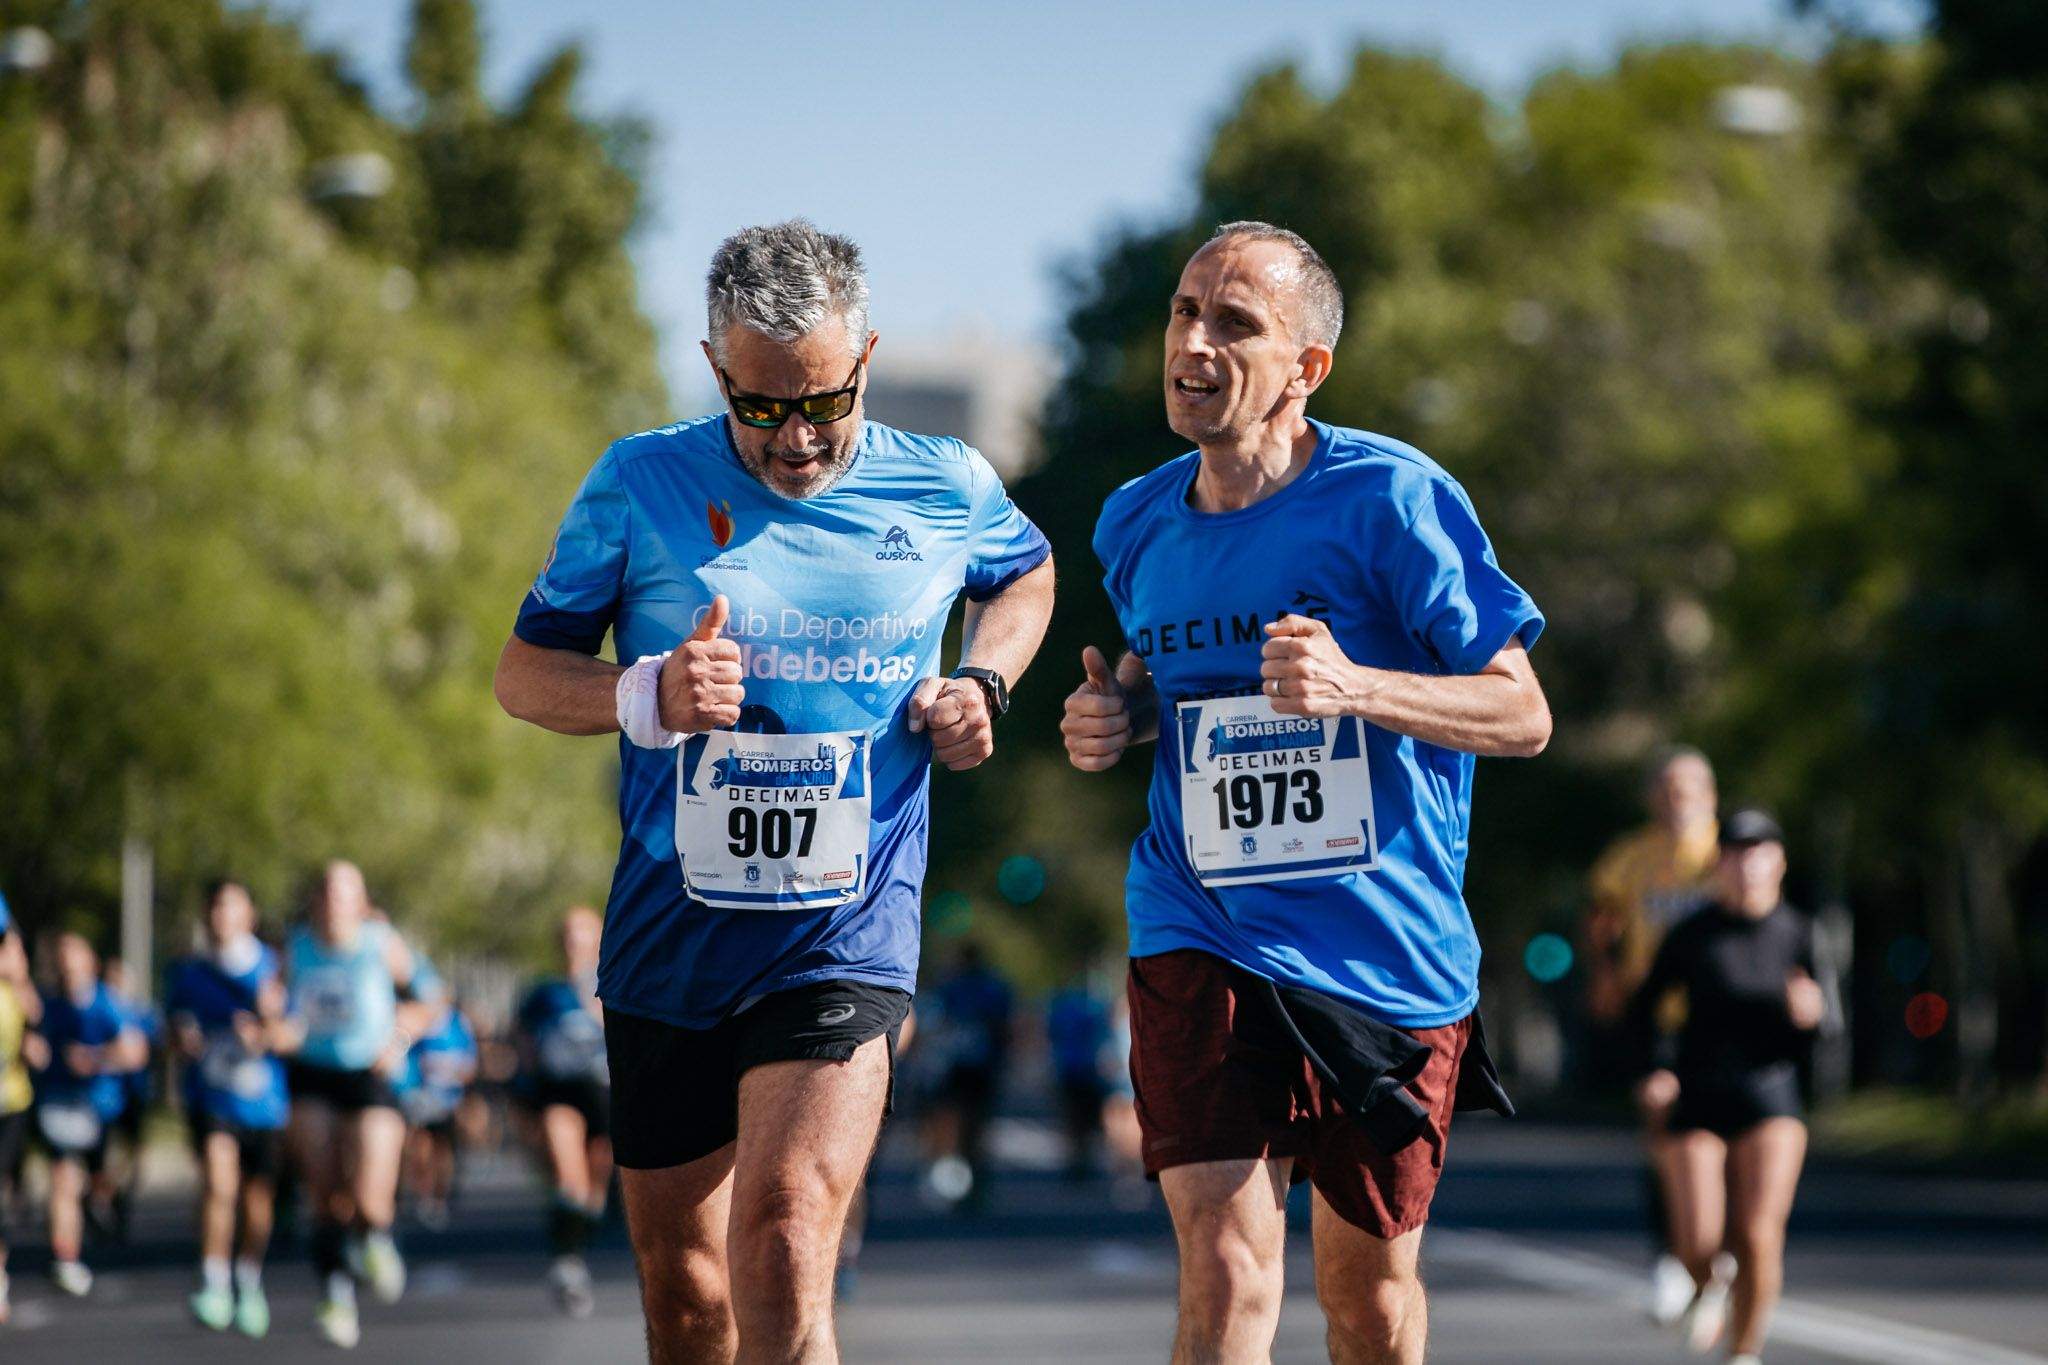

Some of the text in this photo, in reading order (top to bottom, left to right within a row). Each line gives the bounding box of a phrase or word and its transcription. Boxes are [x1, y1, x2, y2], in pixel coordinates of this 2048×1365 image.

[875, 551, 924, 562] austral
[779, 608, 928, 647] Deportivo
[1226, 714, 1258, 724] CARRERA
[1225, 718, 1321, 739] BOMBEROS
[740, 750, 776, 759] CARRERA
[1219, 748, 1322, 772] DECIMAS
[740, 758, 833, 773] BOMBEROS
[729, 788, 830, 803] DECIMAS
[1212, 768, 1324, 831] 1973
[727, 806, 818, 860] 907
